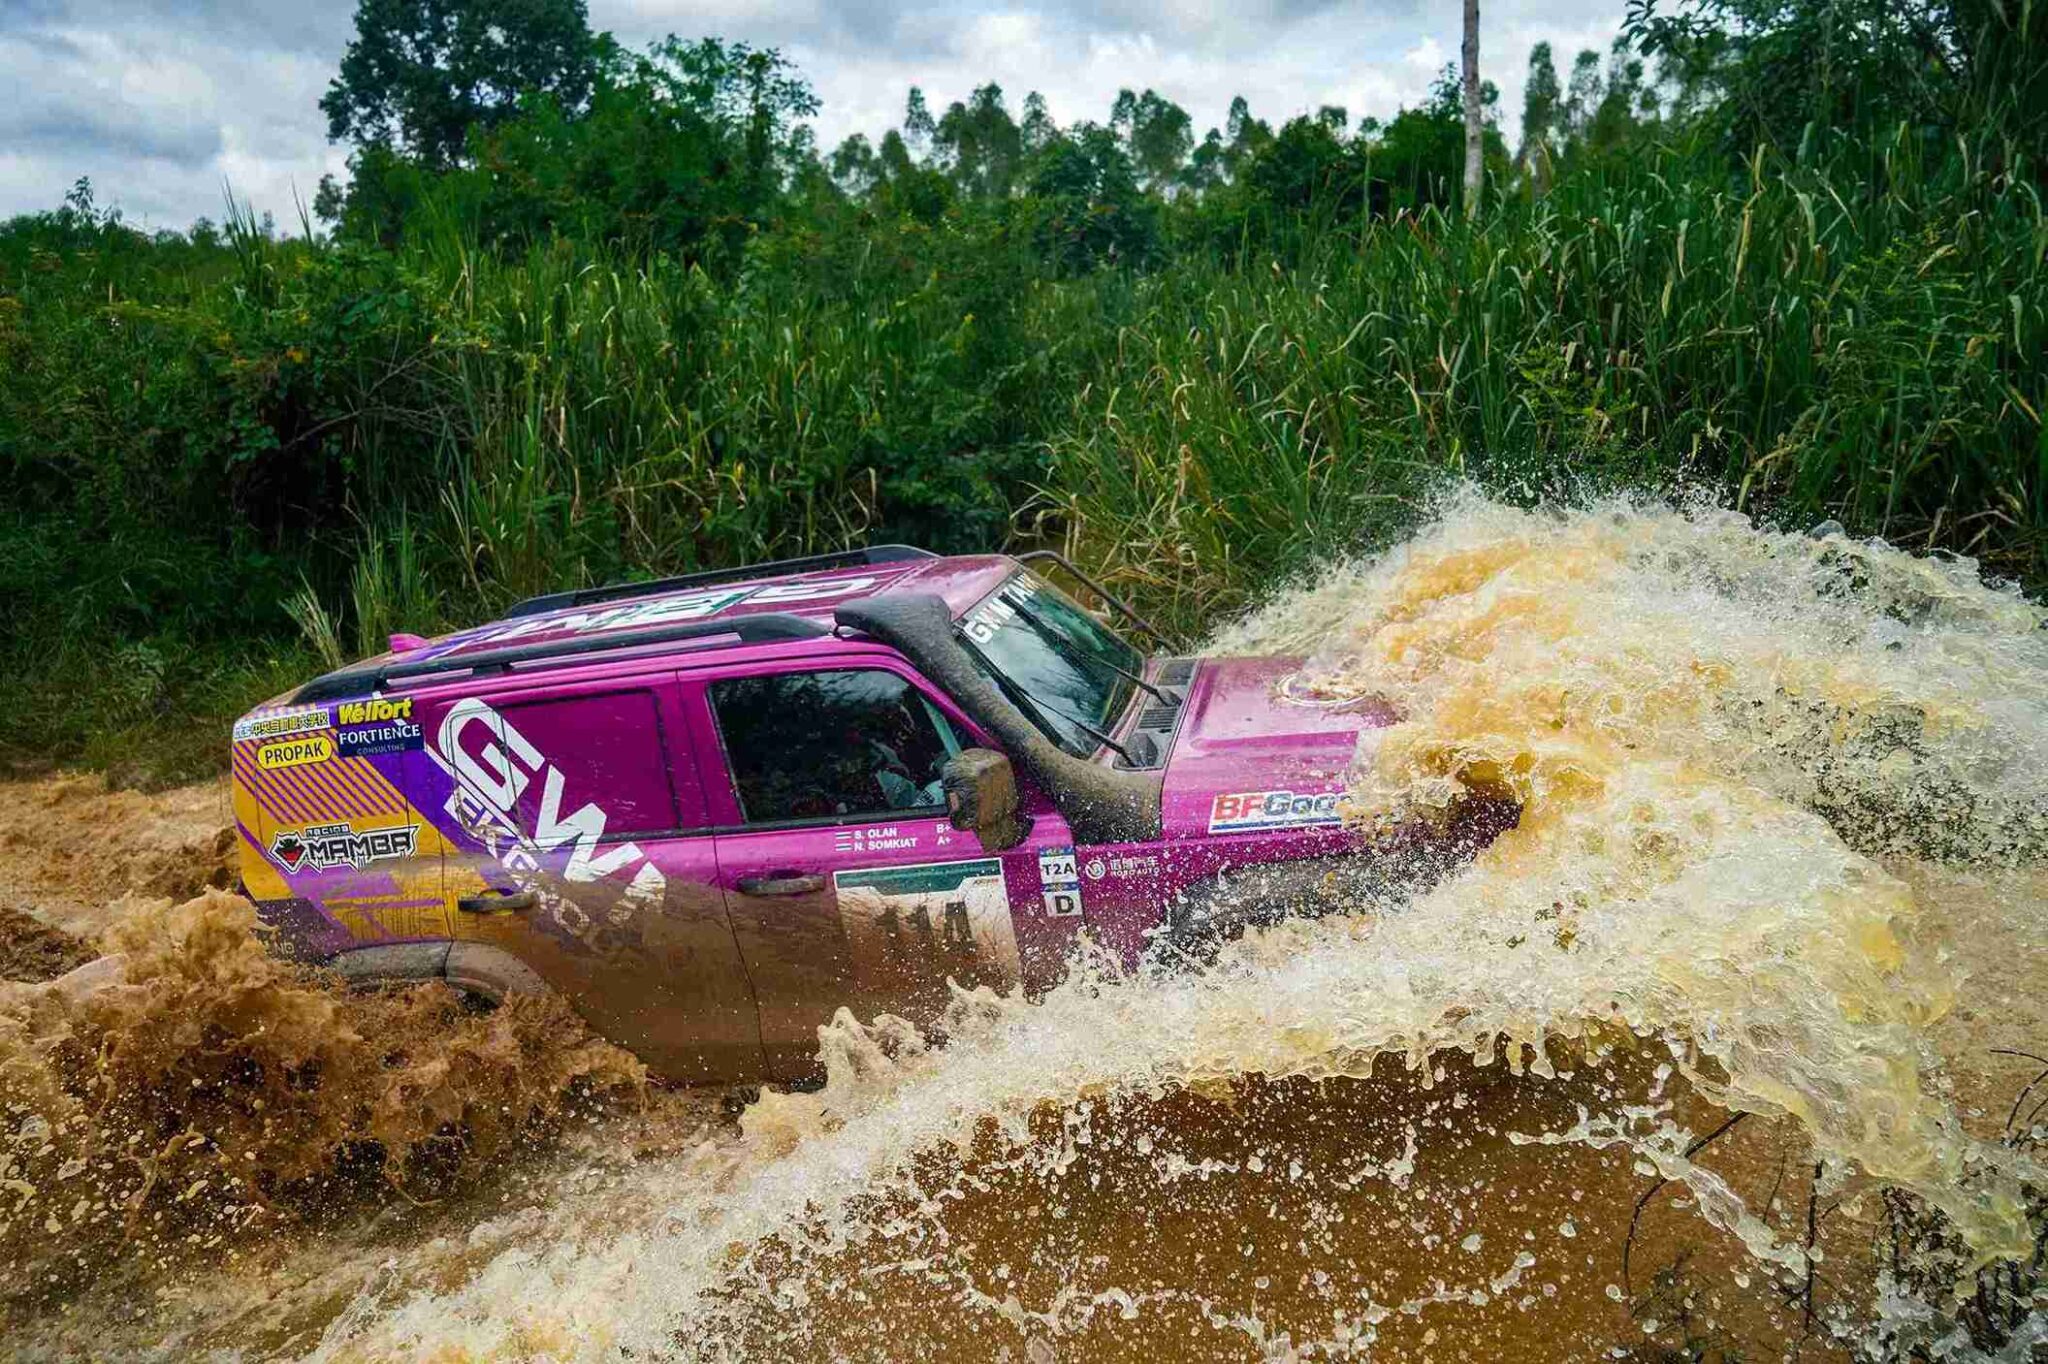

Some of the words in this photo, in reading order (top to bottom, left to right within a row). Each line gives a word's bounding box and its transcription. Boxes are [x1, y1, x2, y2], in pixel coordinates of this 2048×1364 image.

[963, 596, 1017, 644] GWM
[338, 696, 413, 725] Welfort
[339, 724, 421, 745] FORTIENCE
[264, 741, 325, 764] PROPAK
[356, 742, 405, 755] CONSULTING
[853, 830, 865, 840] S.
[867, 827, 898, 839] OLAN
[936, 823, 952, 834] B+
[306, 831, 413, 867] MAMBA
[853, 841, 866, 852] N.
[867, 837, 918, 851] SOMKIAT
[937, 835, 952, 846] A+
[1042, 862, 1075, 876] T2A
[1054, 895, 1074, 914] D
